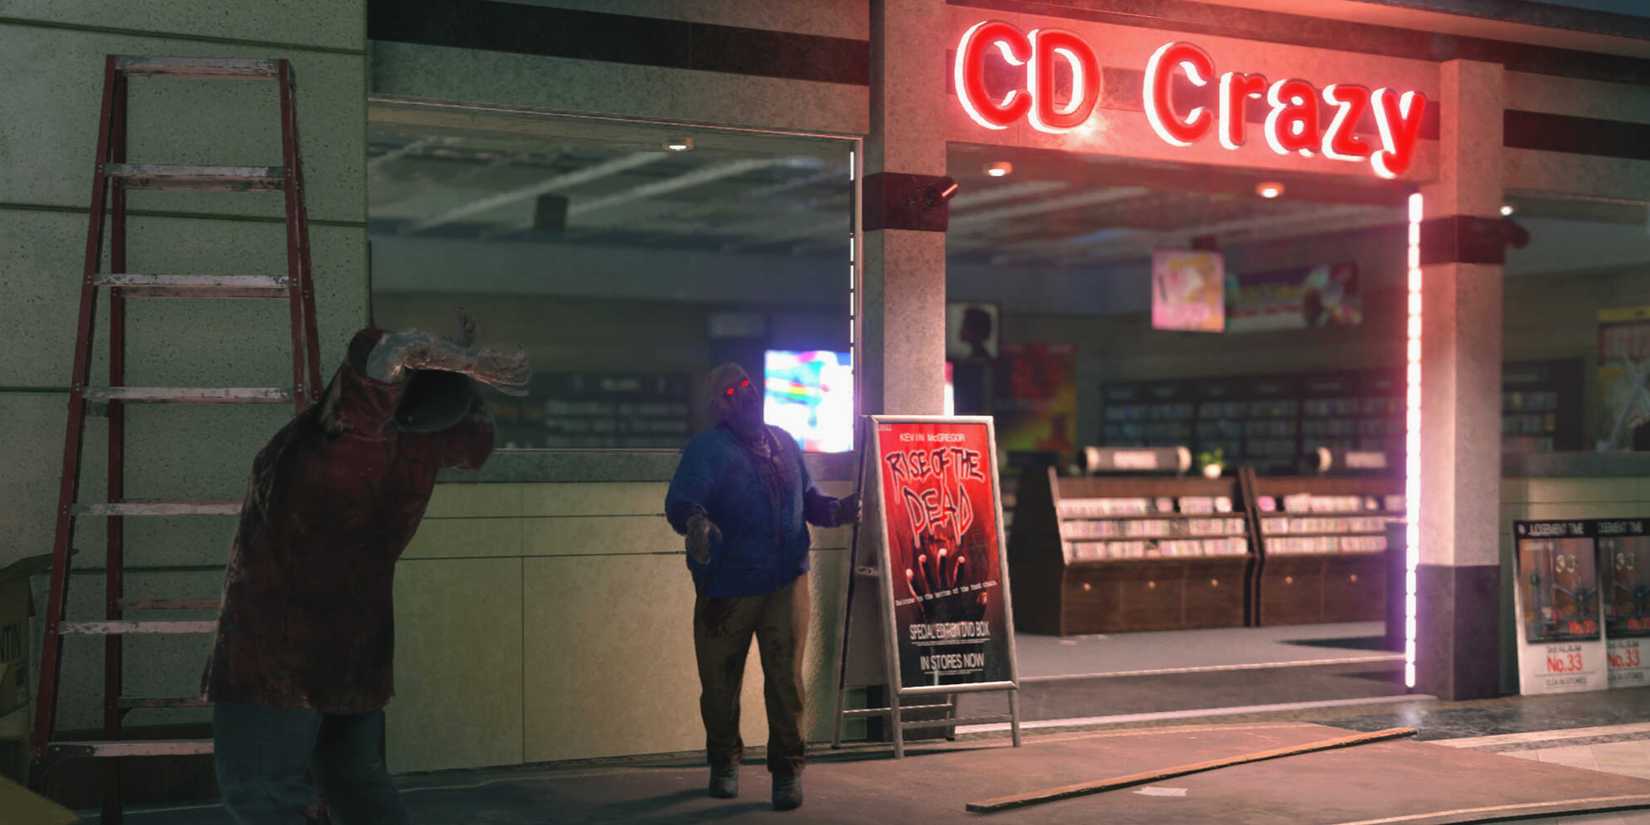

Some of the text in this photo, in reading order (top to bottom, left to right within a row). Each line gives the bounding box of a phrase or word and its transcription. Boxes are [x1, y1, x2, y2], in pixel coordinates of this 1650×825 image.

[954, 20, 1426, 179] CD Crazy
[899, 432, 966, 442] KEVIN McGREGOR
[885, 446, 986, 497] RISE OF THE
[902, 482, 974, 546] DEAD
[909, 620, 991, 640] SPECIAL EDITION DVD BOX
[919, 655, 931, 671] IN
[930, 653, 963, 671] STORES
[962, 651, 985, 668] NOW
[1546, 653, 1584, 673] No.33
